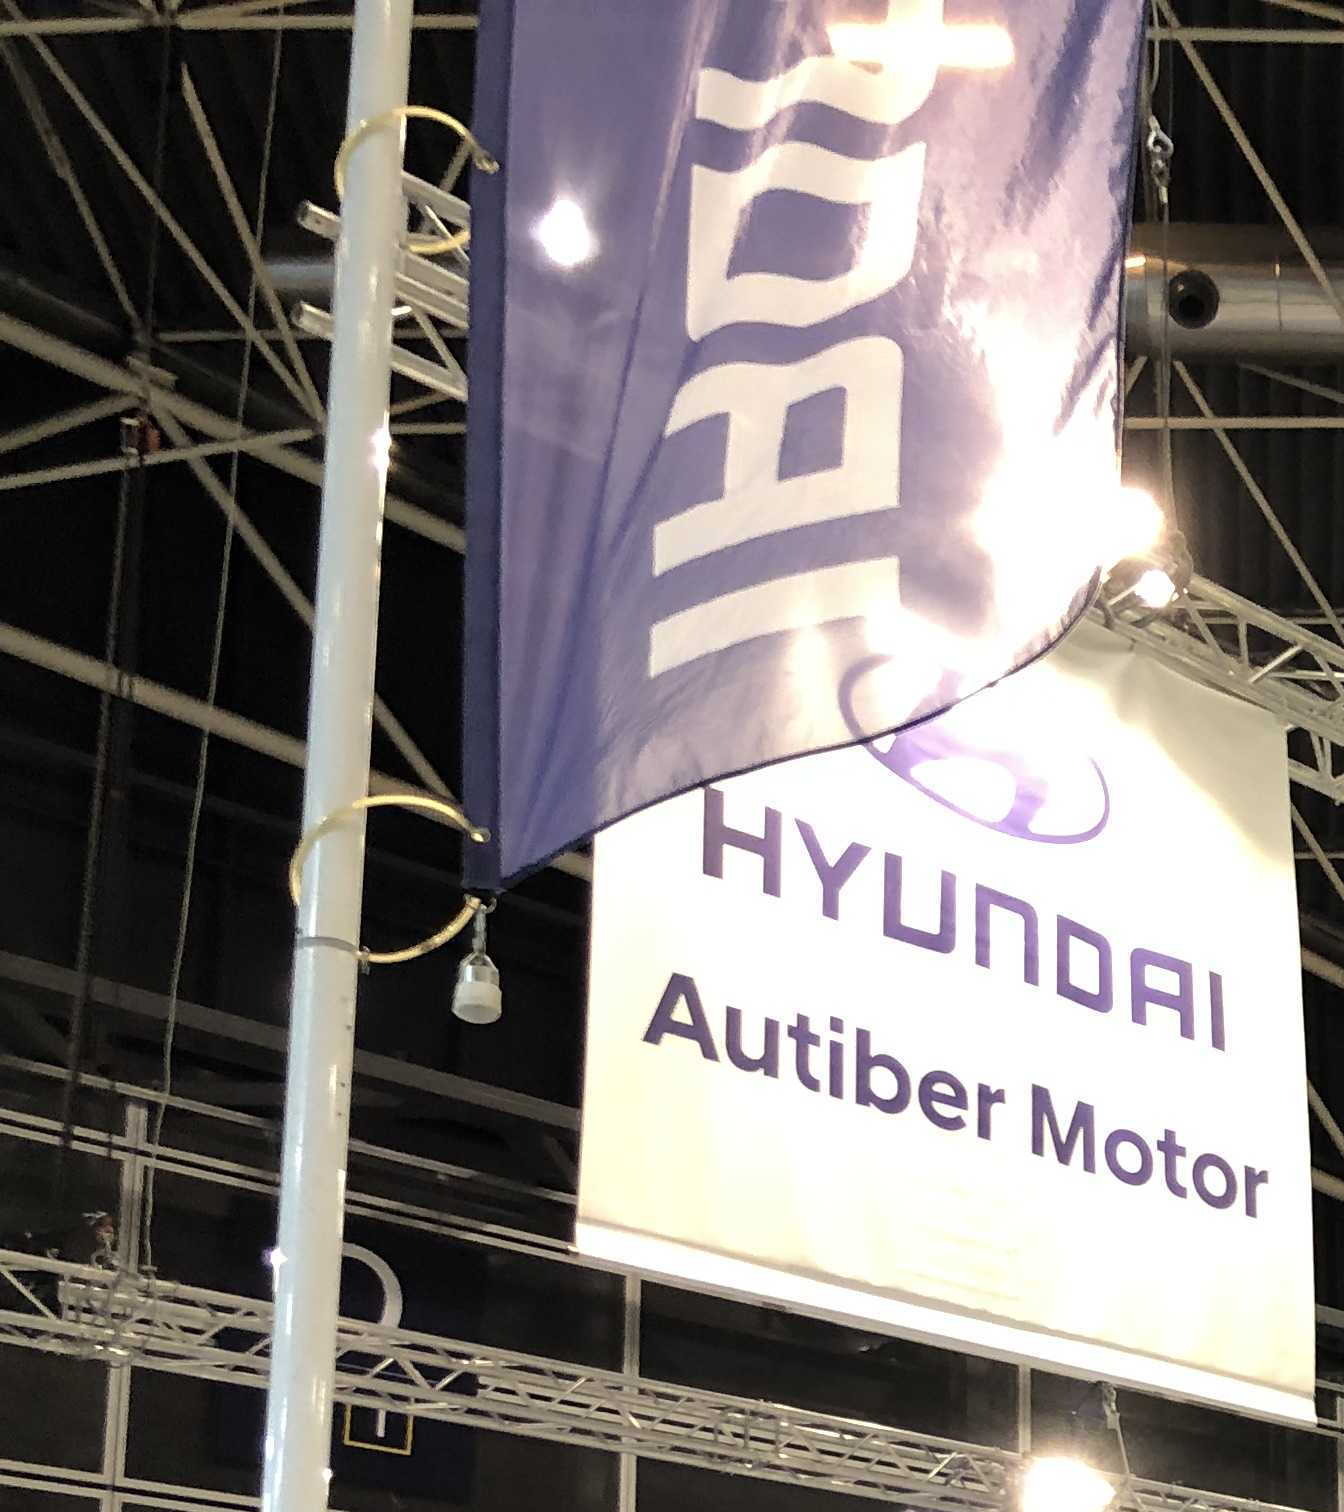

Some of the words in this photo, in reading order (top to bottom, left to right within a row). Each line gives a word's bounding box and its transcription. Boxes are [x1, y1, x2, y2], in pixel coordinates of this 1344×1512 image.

[702, 784, 1226, 1051] HYUNDAI
[643, 973, 1005, 1140] Autiber
[1031, 1084, 1269, 1218] Motor
